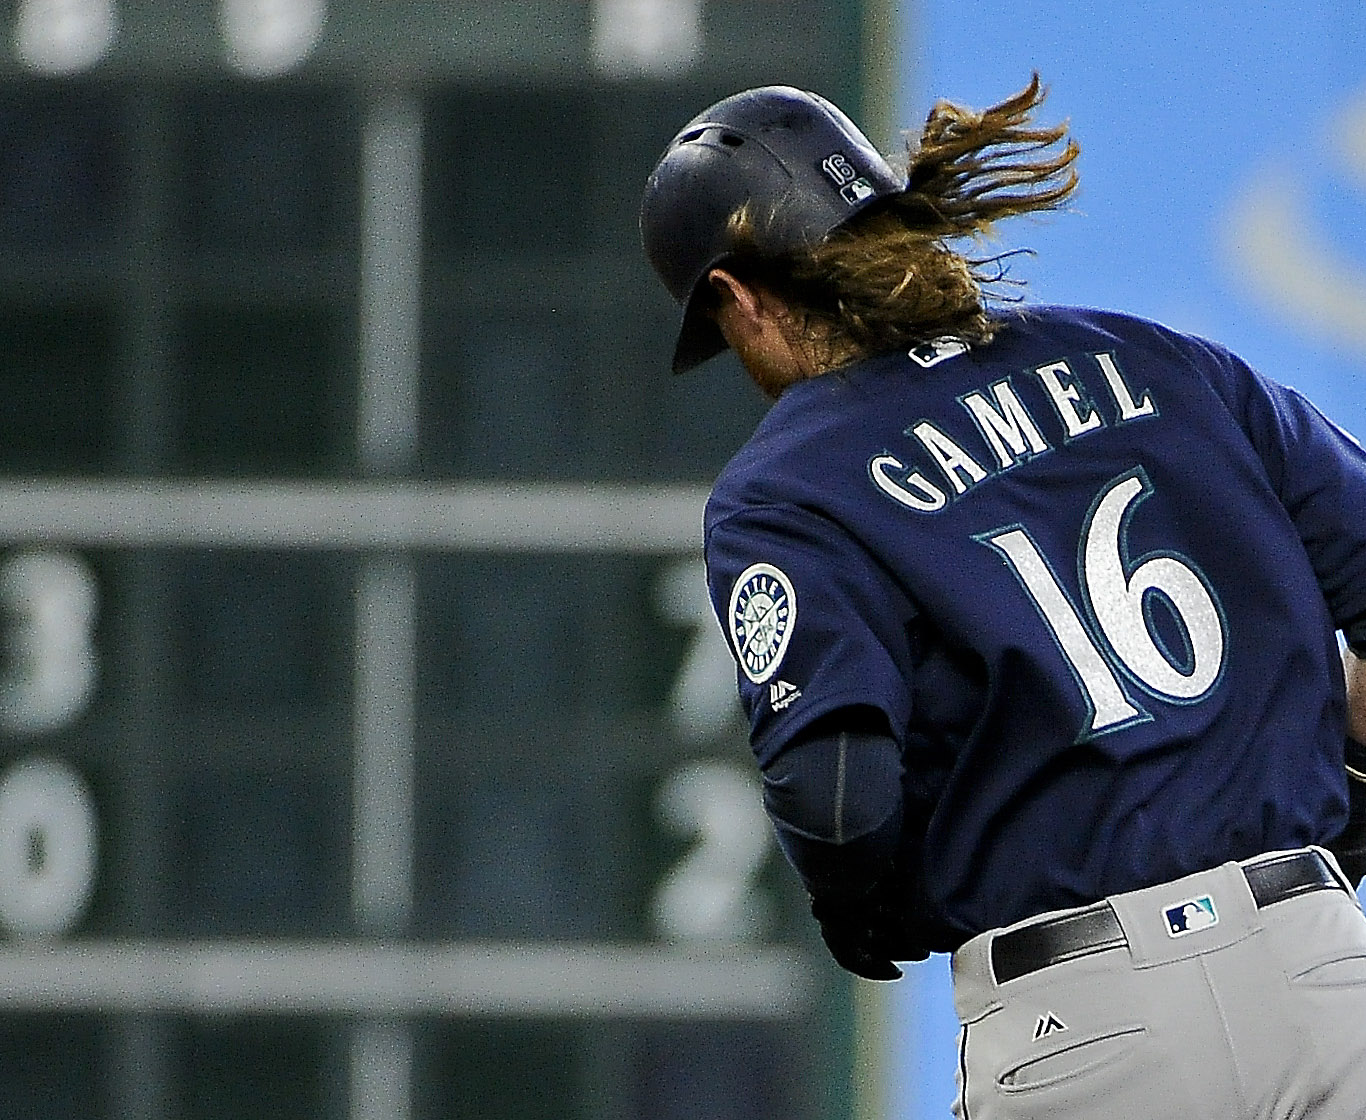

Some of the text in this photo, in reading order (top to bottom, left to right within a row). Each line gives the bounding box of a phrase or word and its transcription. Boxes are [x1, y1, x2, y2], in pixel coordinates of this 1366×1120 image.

[823, 153, 856, 186] 16
[868, 350, 1159, 513] GAMEL
[0, 548, 95, 732] 3
[970, 464, 1230, 744] 16
[0, 758, 774, 942] 0 2
